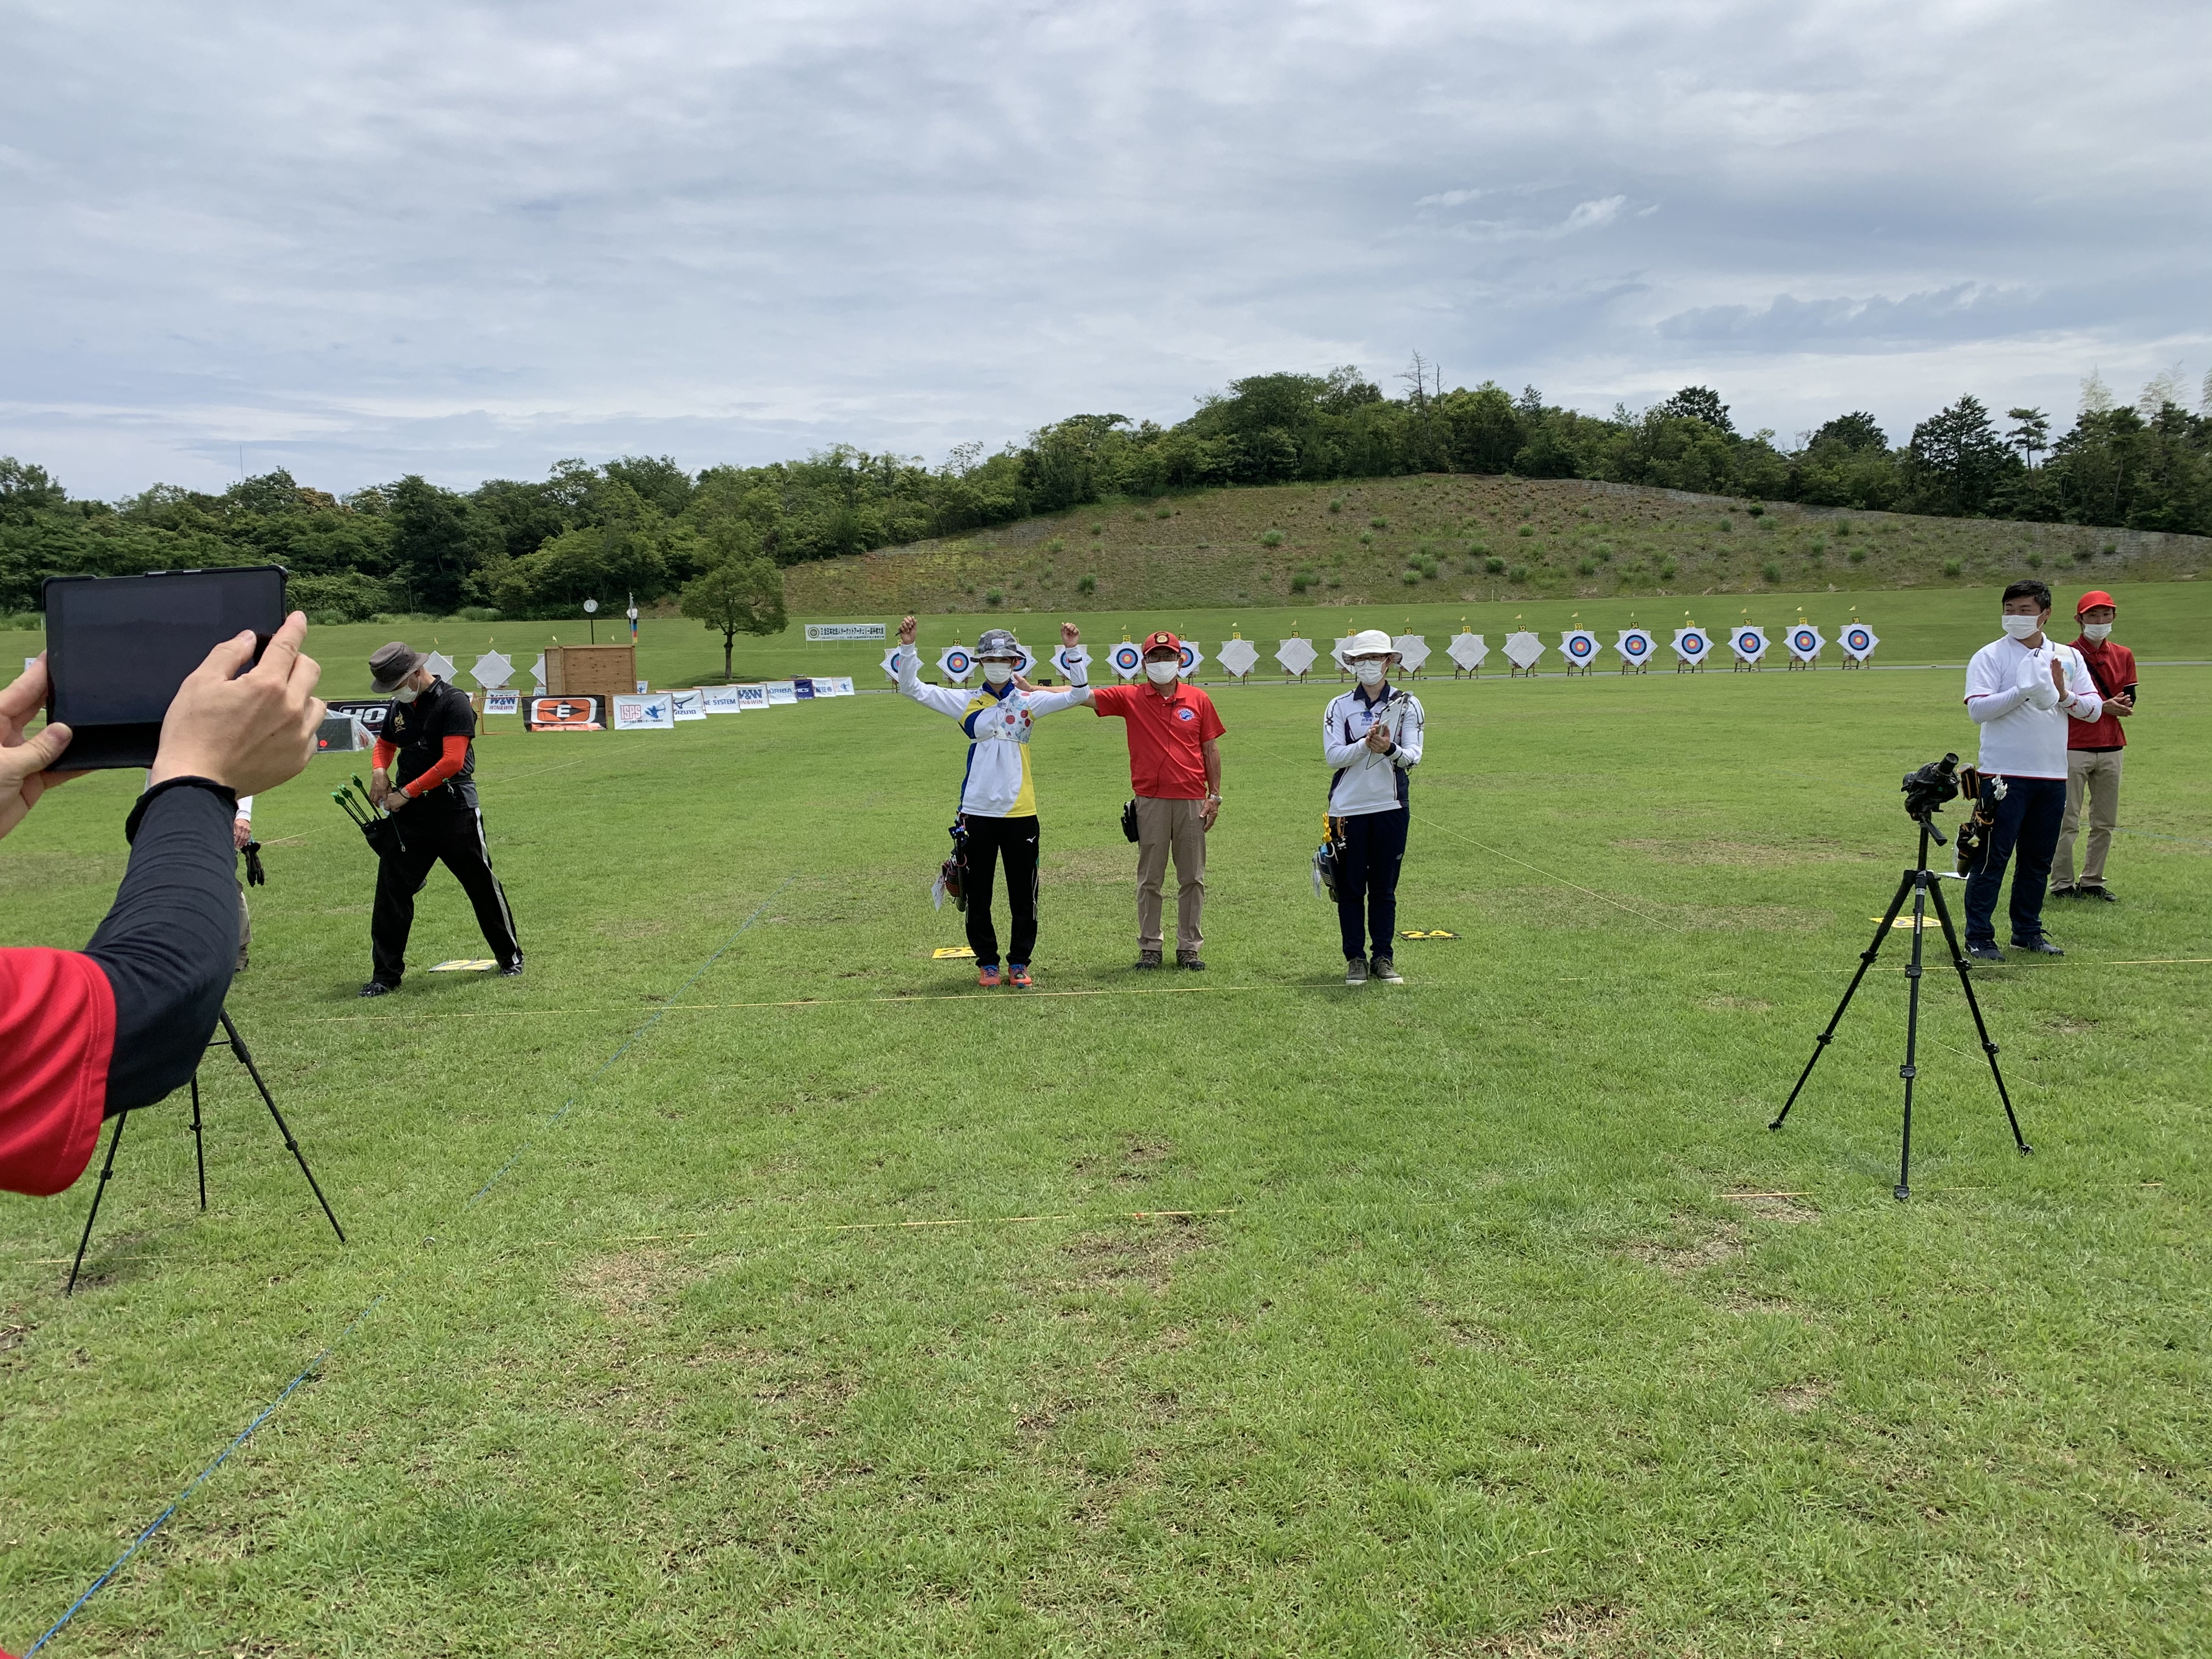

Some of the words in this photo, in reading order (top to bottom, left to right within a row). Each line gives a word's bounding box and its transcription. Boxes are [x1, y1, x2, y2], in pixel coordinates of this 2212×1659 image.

[490, 695, 516, 705] W&W
[342, 708, 387, 723] HO
[556, 704, 571, 718] E
[620, 705, 641, 720] ISPS
[435, 960, 496, 970] 22
